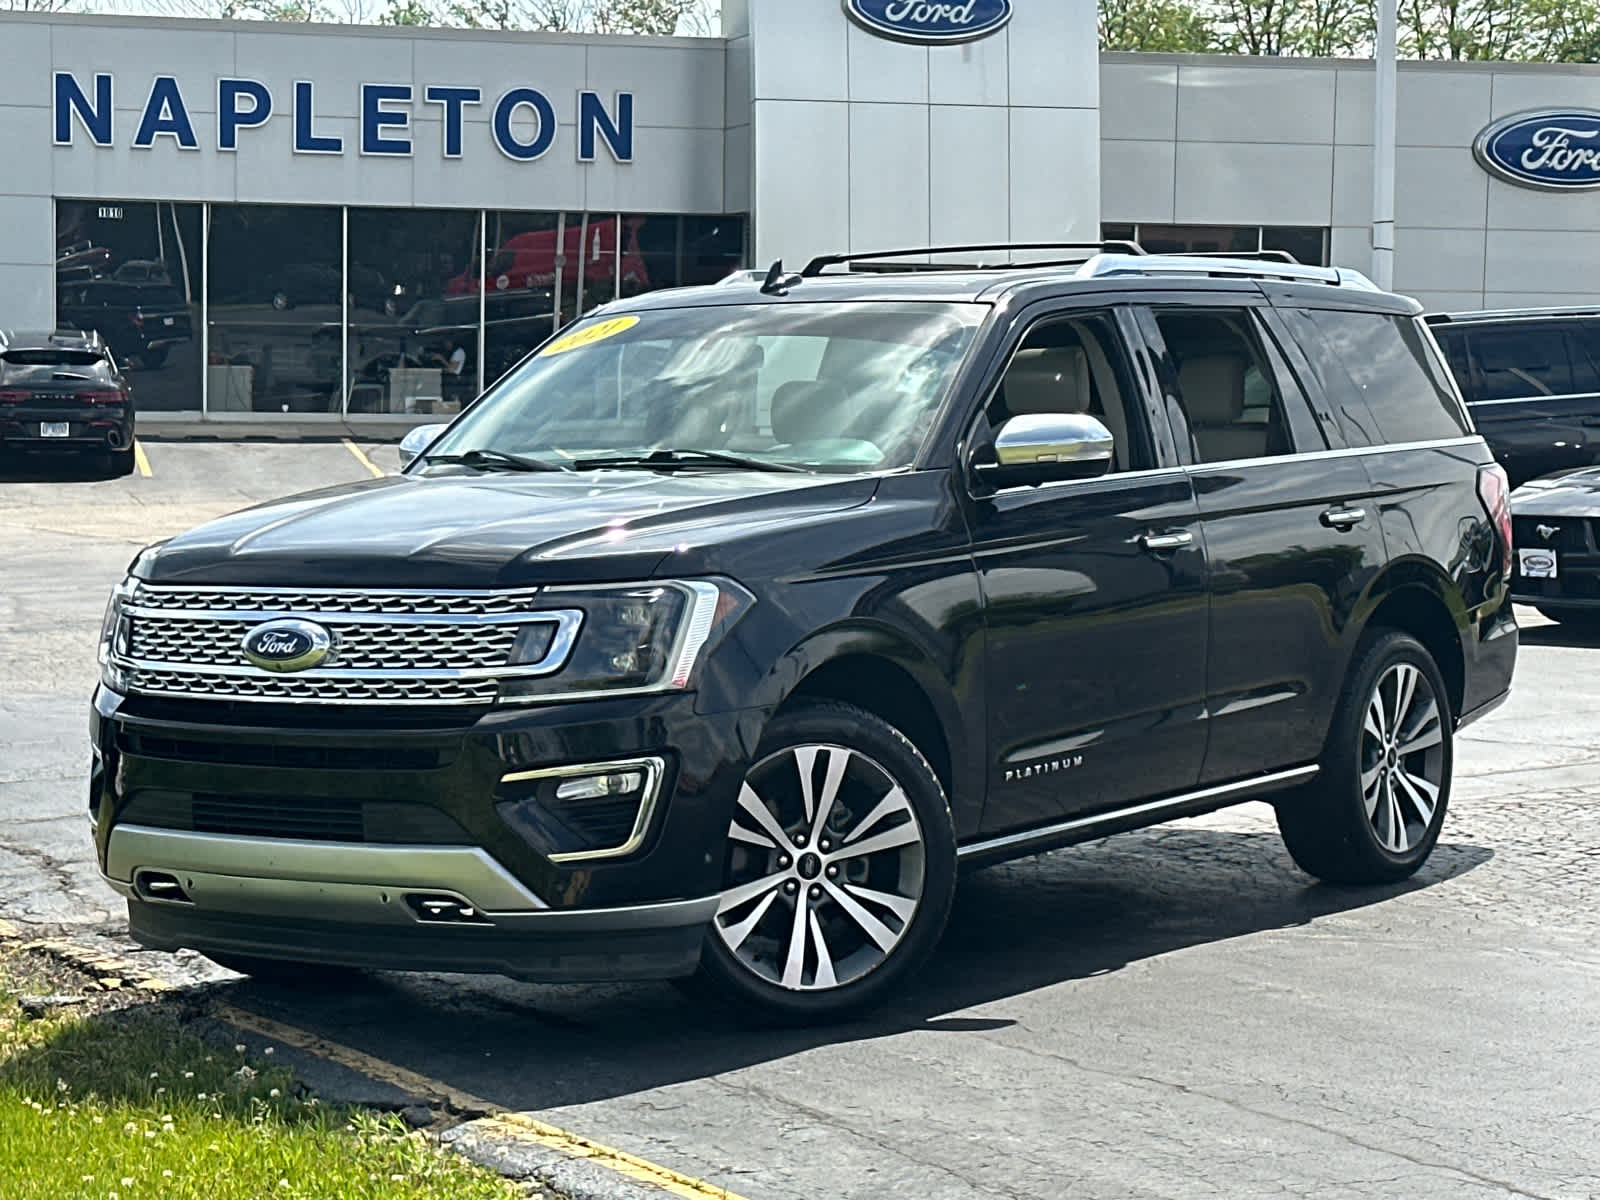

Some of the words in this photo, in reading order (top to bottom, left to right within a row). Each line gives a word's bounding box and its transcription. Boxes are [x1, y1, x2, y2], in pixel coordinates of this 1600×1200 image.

[52, 71, 634, 164] NAPLETON
[98, 206, 123, 219] 1010
[257, 631, 298, 654] Ford
[1005, 755, 1083, 782] PLATINUM
